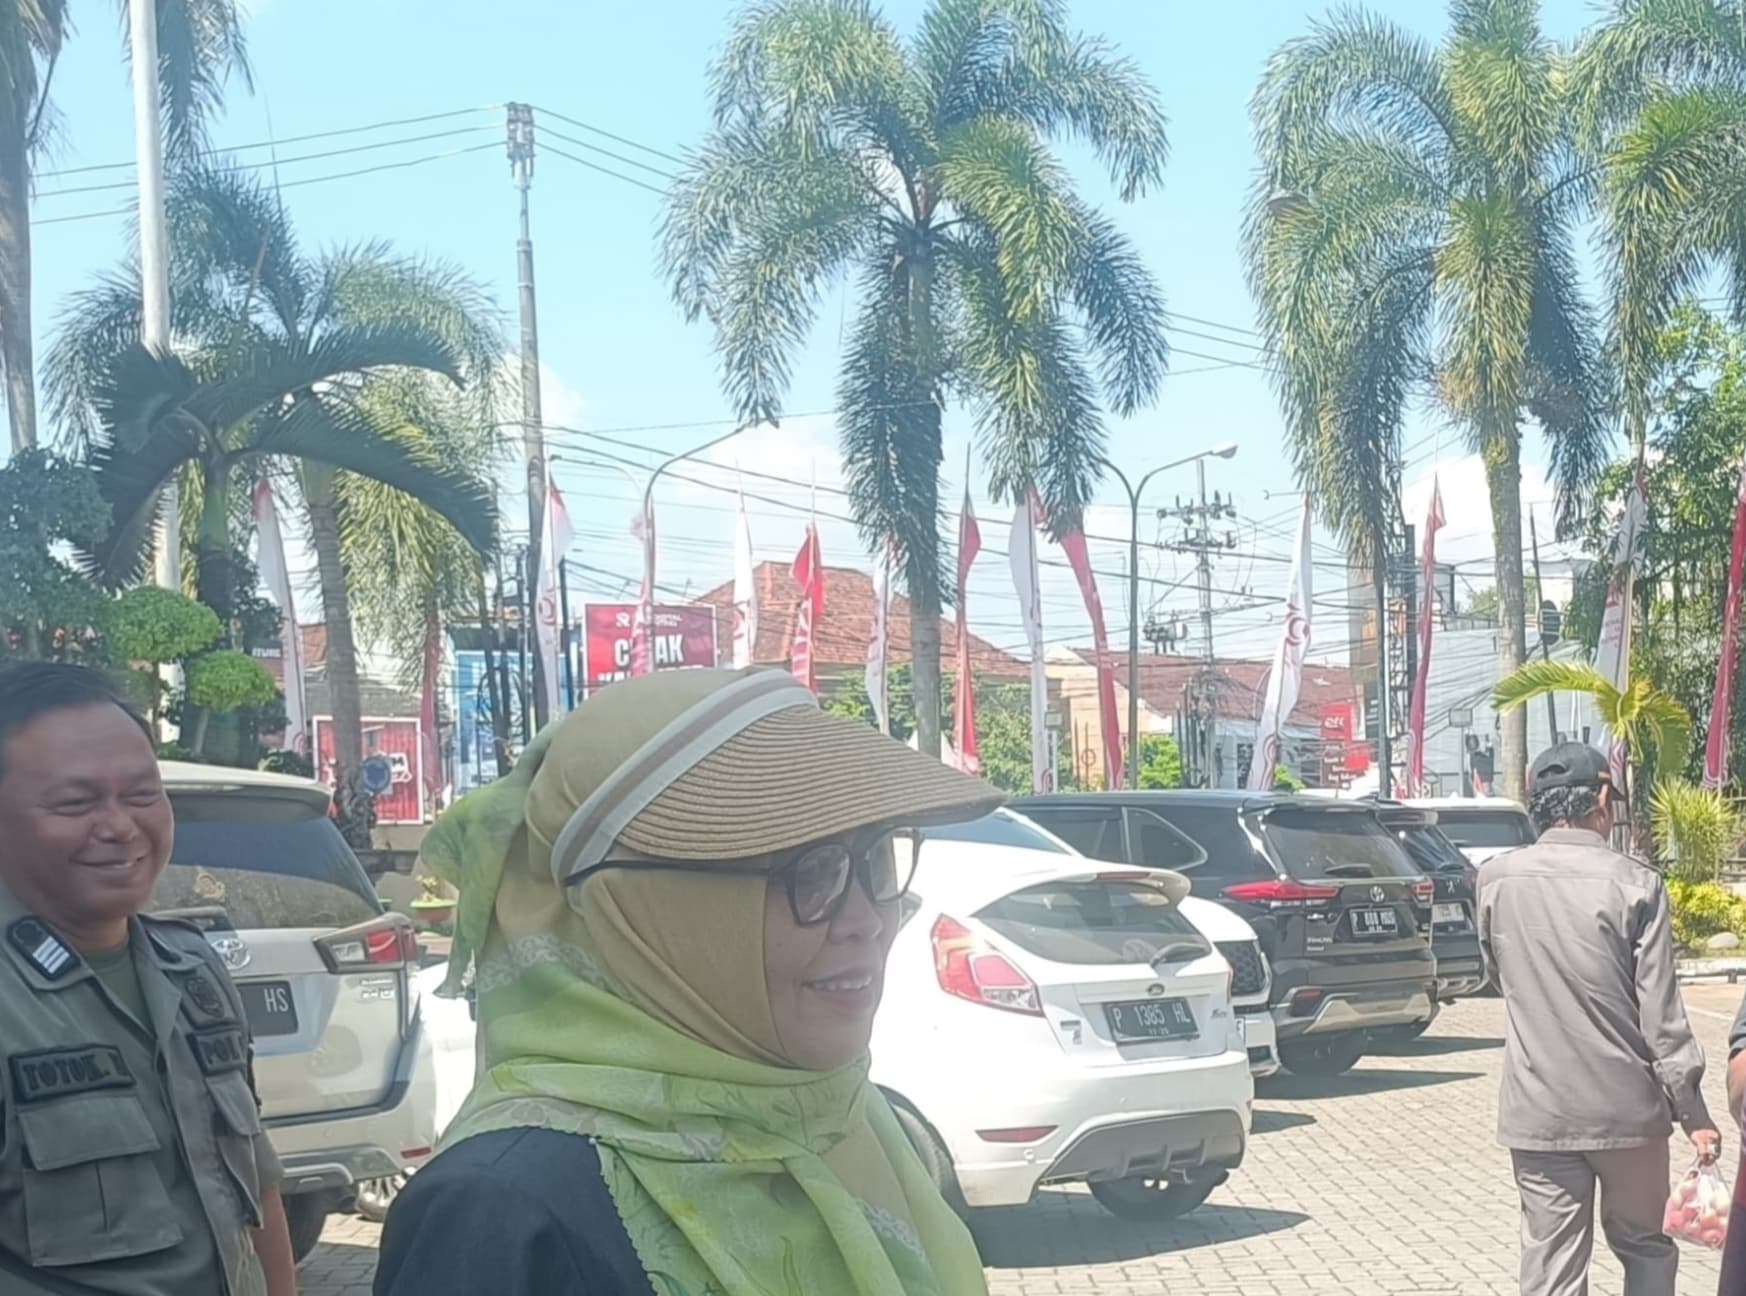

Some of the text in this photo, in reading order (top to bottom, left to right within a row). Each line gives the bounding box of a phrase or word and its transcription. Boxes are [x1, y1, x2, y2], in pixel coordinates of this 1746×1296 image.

[264, 988, 289, 1013] HS
[1113, 1007, 1122, 1029] P
[1133, 1002, 1165, 1028] 1385
[1174, 1001, 1192, 1023] HL
